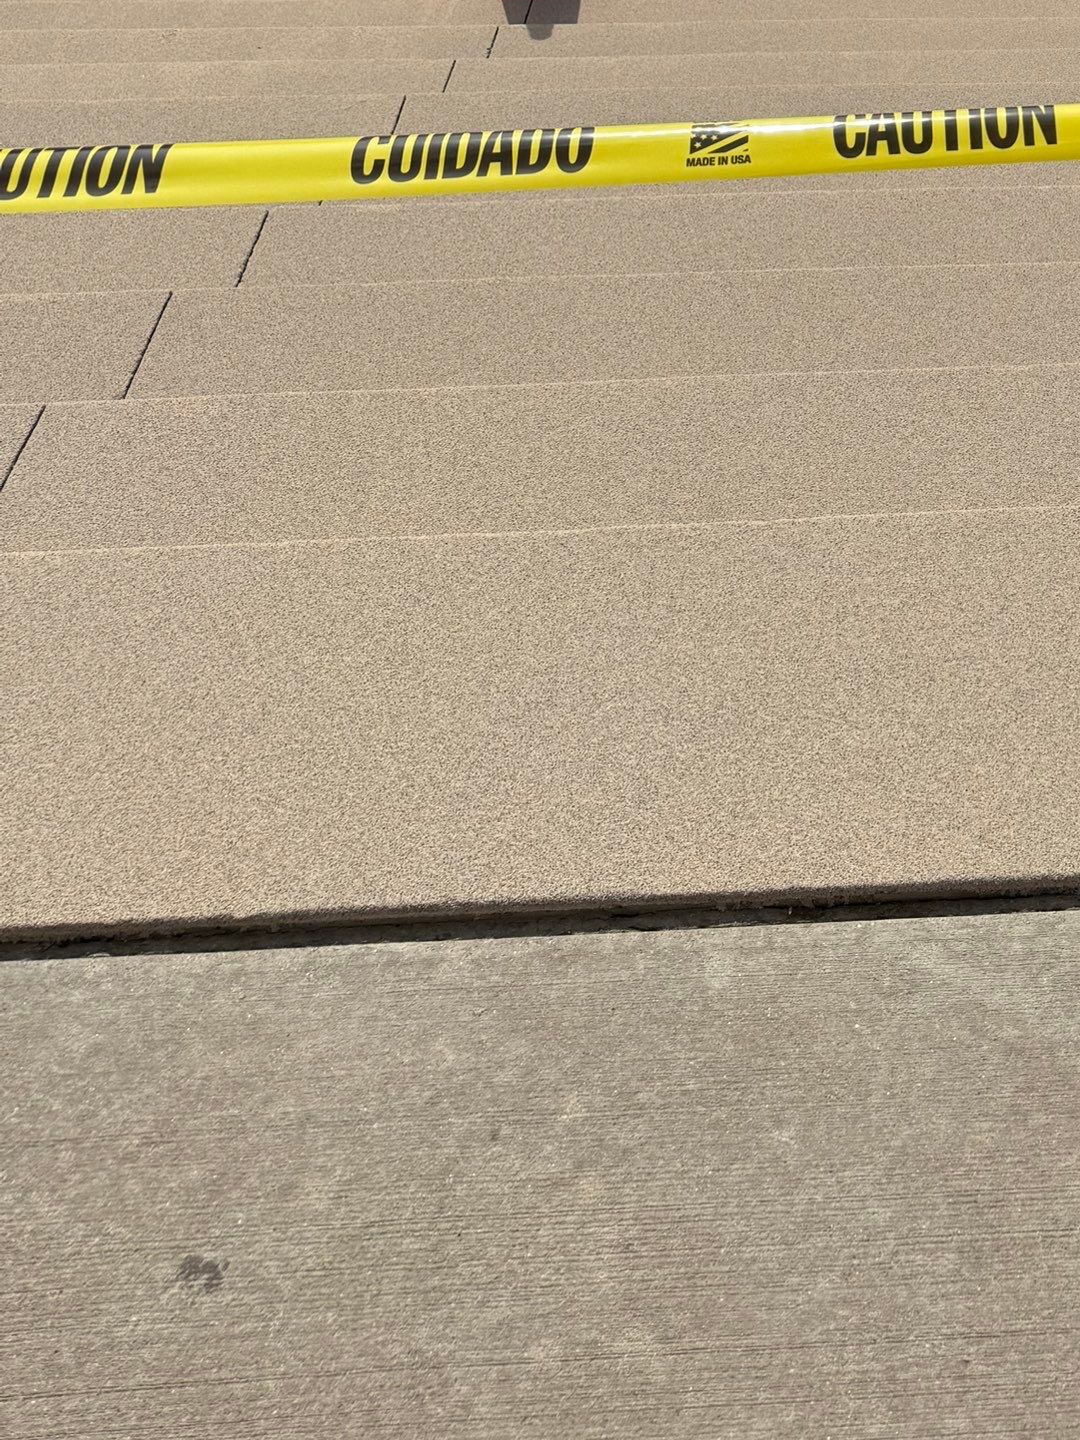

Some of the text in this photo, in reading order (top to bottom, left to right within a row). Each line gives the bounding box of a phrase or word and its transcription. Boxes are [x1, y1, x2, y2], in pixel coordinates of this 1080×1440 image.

[351, 126, 595, 185] CUIDADO
[833, 105, 1057, 158] CAUTION
[0, 143, 173, 200] UTION
[686, 154, 752, 167] MADE IN USA
